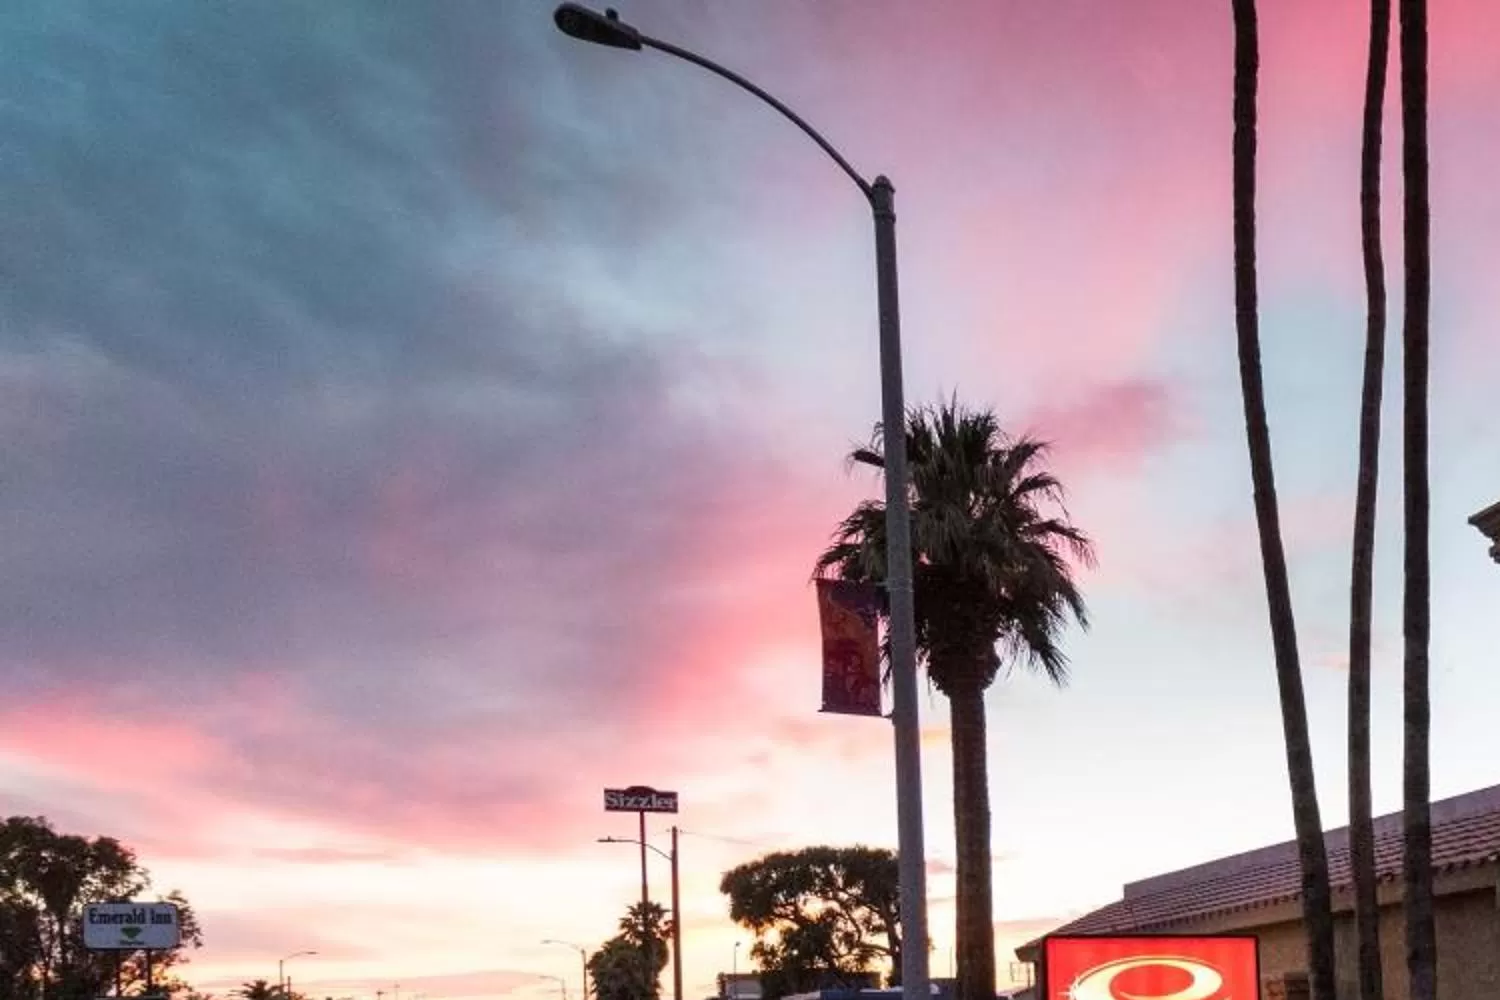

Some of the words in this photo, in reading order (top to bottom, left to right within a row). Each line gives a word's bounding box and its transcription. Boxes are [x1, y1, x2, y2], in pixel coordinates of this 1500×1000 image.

[605, 792, 677, 809] Sizzler
[88, 907, 146, 925] Emerald
[149, 908, 173, 925] Inn
